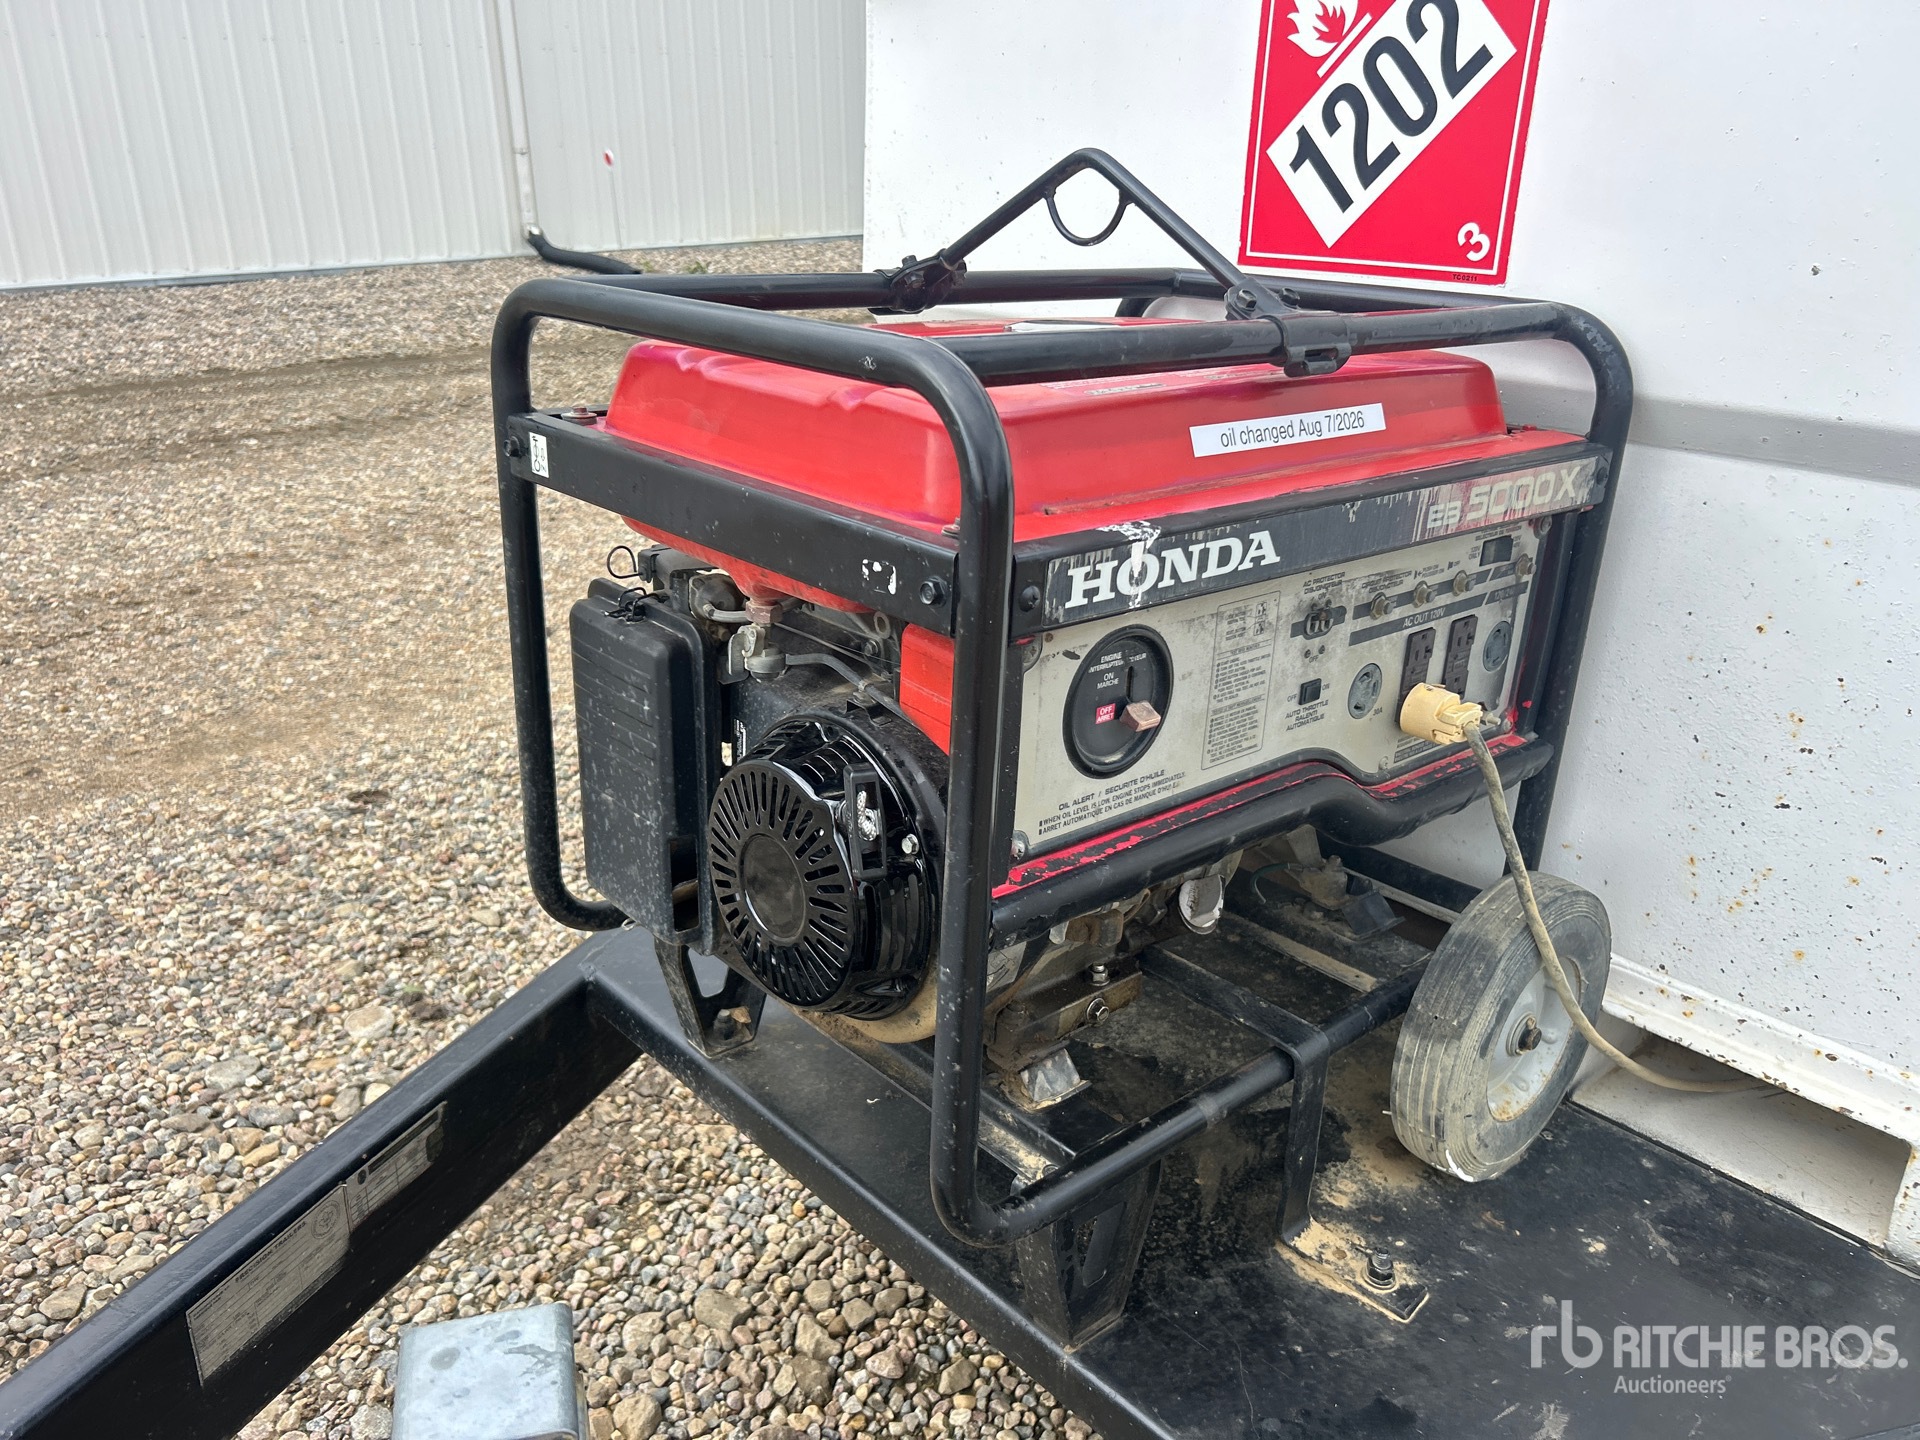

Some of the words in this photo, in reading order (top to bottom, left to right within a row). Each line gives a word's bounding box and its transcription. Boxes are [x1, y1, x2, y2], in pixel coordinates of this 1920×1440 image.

[1289, 0, 1494, 214] 1202
[1457, 222, 1491, 262] 3
[1220, 428, 1237, 448] oil
[1239, 420, 1295, 444] changed
[1299, 418, 1323, 437] Aug
[1324, 410, 1365, 433] 7/2026
[1427, 500, 1462, 529] EB
[1466, 465, 1581, 520] 5000X
[1064, 530, 1281, 609] HONDA
[1312, 572, 1346, 585] PROTECTOR
[1402, 618, 1412, 628] AC
[1414, 612, 1430, 624] OUT
[1430, 608, 1446, 620] 120V
[1100, 652, 1122, 664] ENGINE
[1308, 654, 1319, 663] OFF
[1096, 678, 1120, 690] MARCHE
[1104, 672, 1115, 680] ON
[1287, 694, 1298, 702] OFF
[1096, 712, 1114, 724] ARRET
[1100, 706, 1112, 715] OFF
[1285, 708, 1301, 720] AUTO
[1302, 700, 1329, 713] THROTTLE
[1295, 710, 1318, 722] RALENTI
[1286, 714, 1325, 732] AUTOMATIQUE
[1058, 802, 1070, 810] OIL
[1072, 792, 1095, 806] ALERT
[1105, 778, 1138, 795] SECURITE
[1140, 770, 1165, 784] D'HUILE
[1043, 822, 1062, 834] ARRET
[1062, 807, 1104, 828] AUTOMATIQUE
[1113, 800, 1124, 809] CAS
[1134, 788, 1156, 800] MANQUE
[1044, 814, 1061, 826] WHEN
[1062, 811, 1072, 819] OIL
[1073, 805, 1090, 816] LEVEL
[1112, 790, 1133, 802] ENGINE
[1134, 784, 1150, 794] STOPS
[235, 1249, 274, 1284] PRECISION
[274, 1220, 307, 1250] TRAILERS
